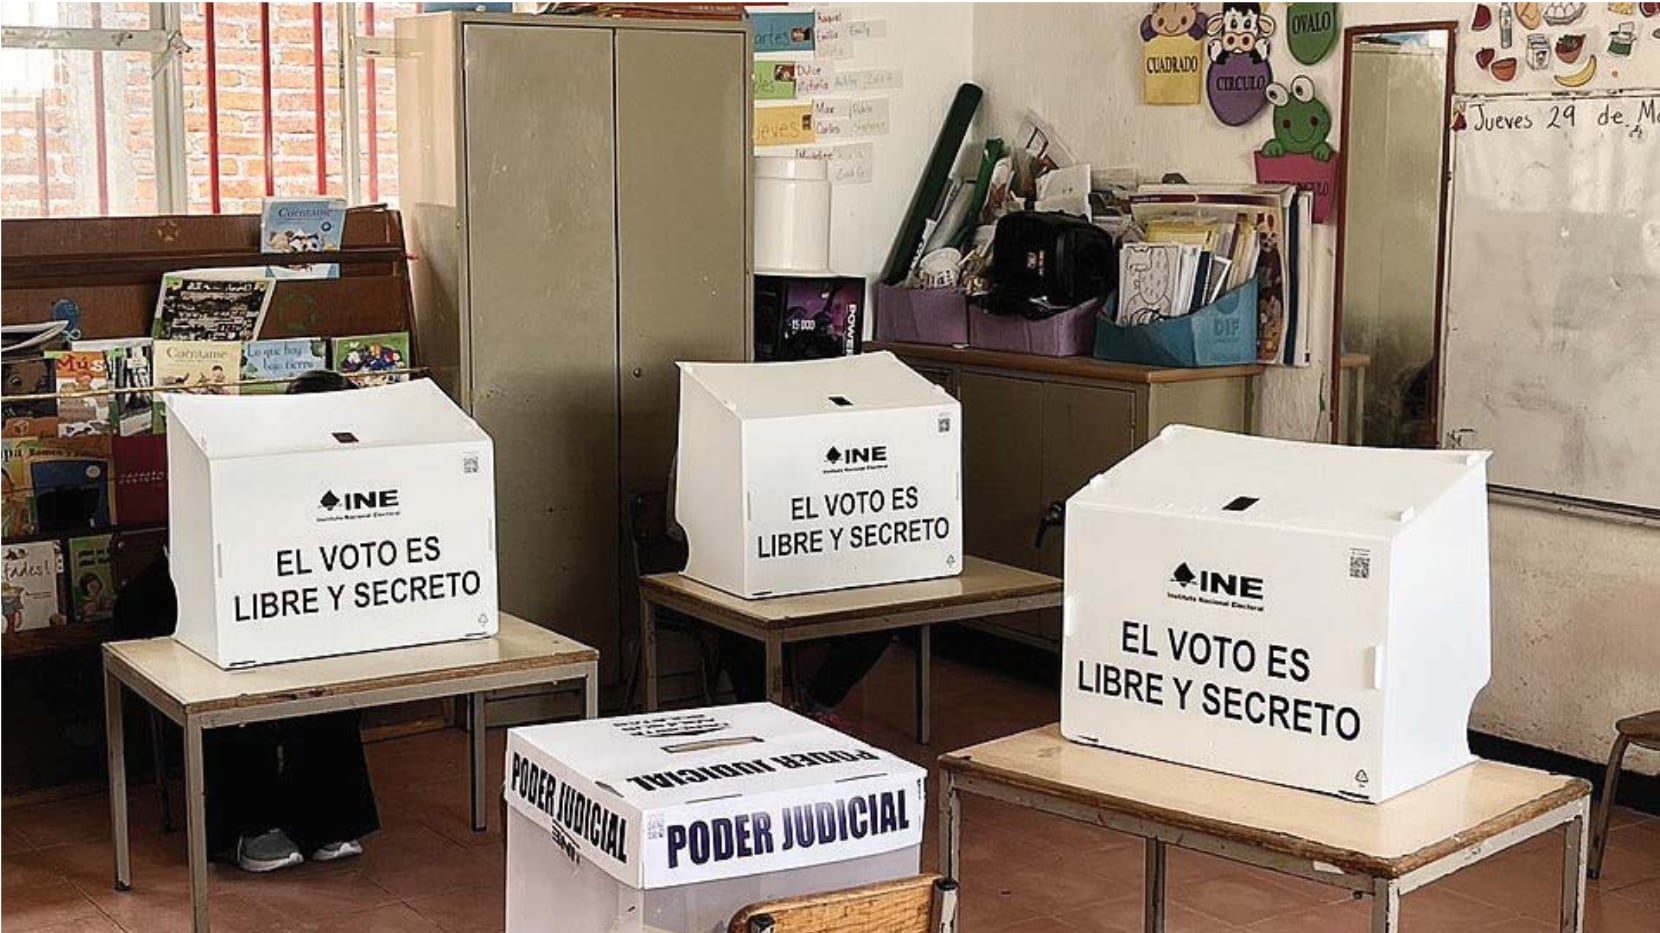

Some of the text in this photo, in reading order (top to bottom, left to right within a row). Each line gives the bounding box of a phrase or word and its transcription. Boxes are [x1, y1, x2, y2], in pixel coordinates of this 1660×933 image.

[1291, 11, 1331, 35] OVALO
[1146, 55, 1198, 74] CUADRADO
[1216, 75, 1266, 92] CIRCULO
[1469, 104, 1534, 131] Jueves
[1546, 105, 1576, 130] 29
[1597, 103, 1624, 126] de
[1214, 318, 1240, 337] DIF
[844, 446, 887, 464] INE
[344, 489, 400, 511] INE
[791, 486, 918, 520] EL VOTO ES
[758, 517, 950, 558] LIBRE Y SECRETO
[277, 535, 441, 577] EL VOTO ES
[234, 570, 481, 622] LIBRE Y SECRETO
[1200, 570, 1264, 600] INE
[1122, 620, 1311, 683] EL VOTO ES
[1078, 660, 1362, 741] LIBRE Y SECRETO
[626, 749, 880, 792] PODER JUDICIAL
[511, 752, 628, 864] PODER JUDICIAL
[667, 789, 911, 869] PODER JUDICIAL
